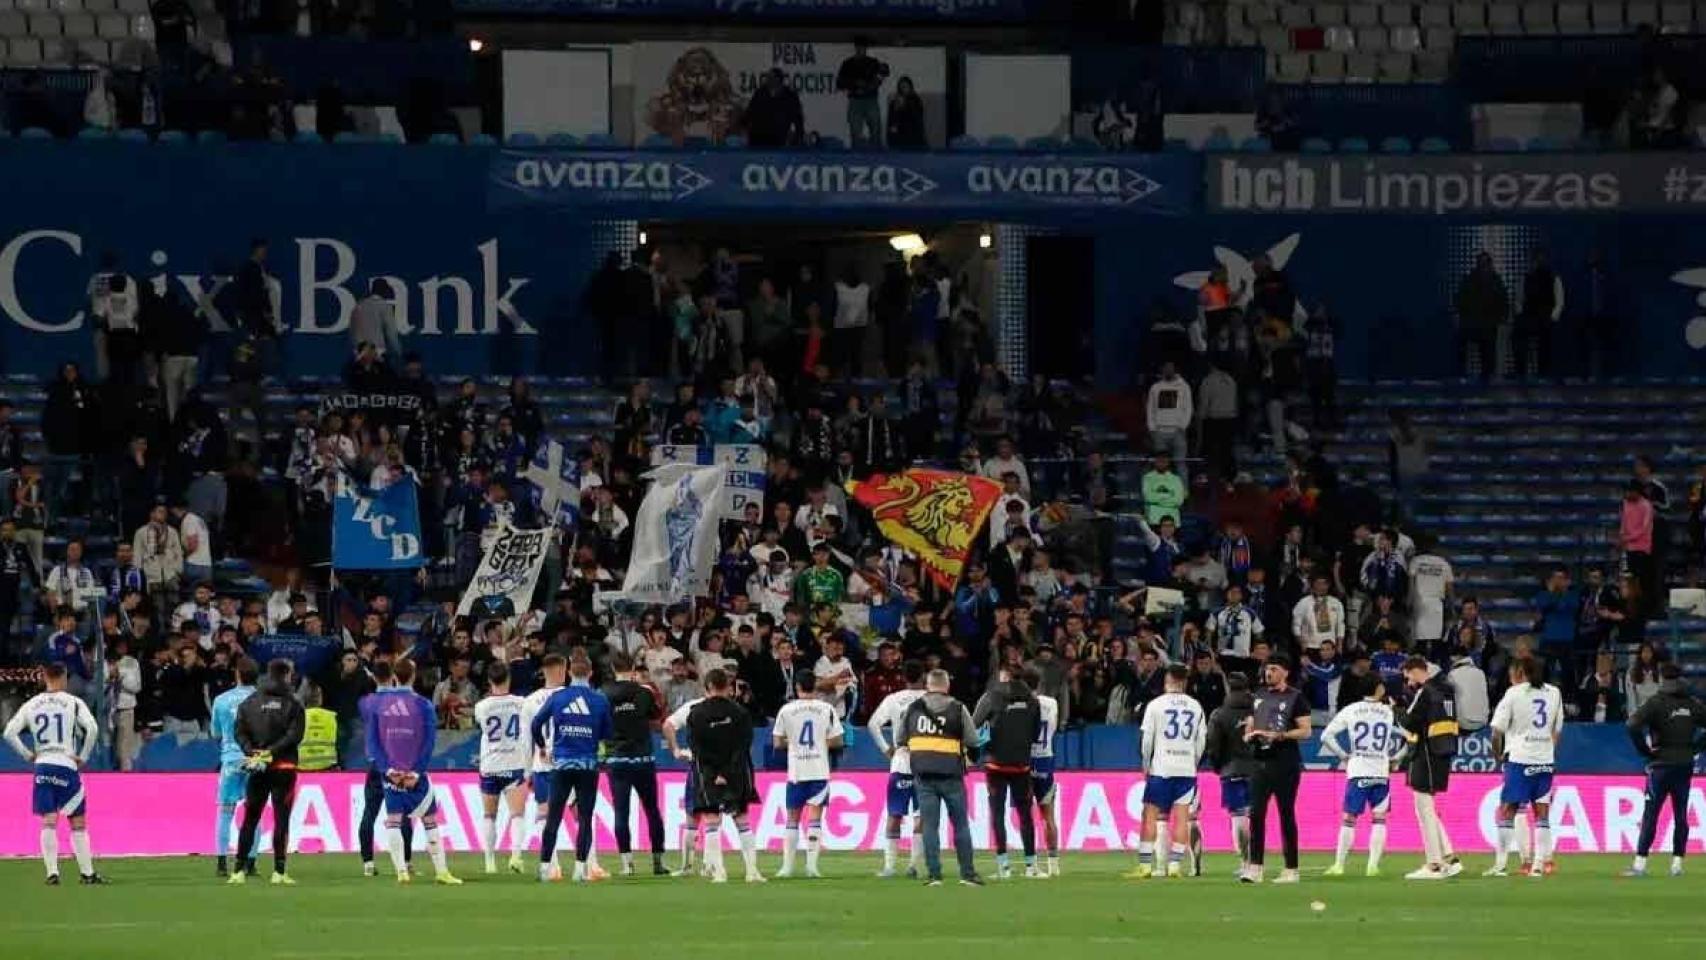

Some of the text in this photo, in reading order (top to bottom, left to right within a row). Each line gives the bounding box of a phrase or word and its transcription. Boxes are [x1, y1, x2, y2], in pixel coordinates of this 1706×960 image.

[515, 160, 672, 189] avanza
[742, 164, 897, 192] avanza
[967, 165, 1121, 193] avanza
[1222, 159, 1621, 215] bcb Limpiezas
[0, 229, 538, 335] CixBank
[35, 713, 64, 744] 21
[486, 714, 520, 743] 24
[1164, 709, 1195, 740] 33
[1532, 698, 1547, 729] 3
[799, 719, 815, 749] 4
[1354, 721, 1388, 751] 29
